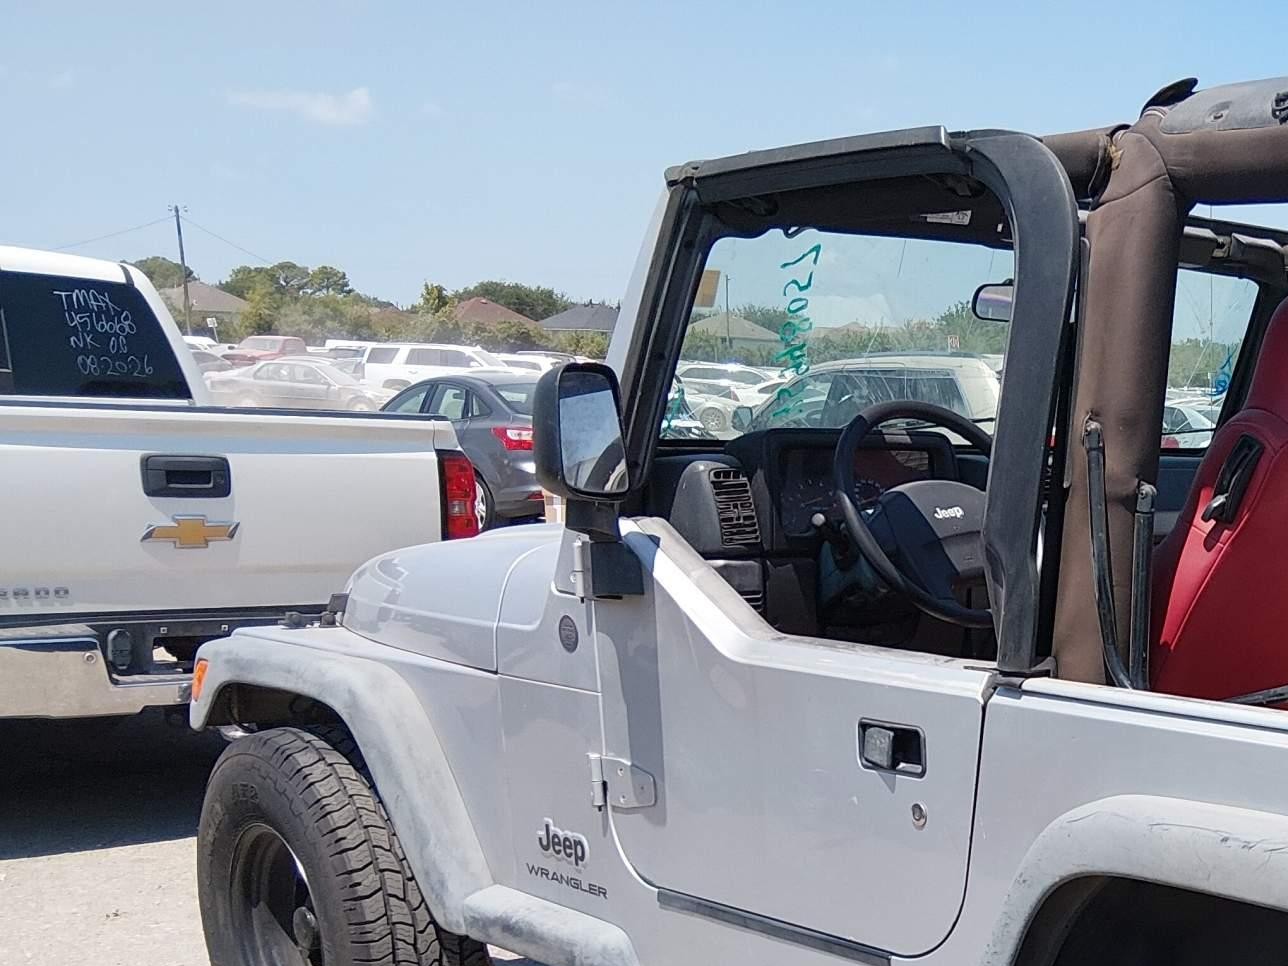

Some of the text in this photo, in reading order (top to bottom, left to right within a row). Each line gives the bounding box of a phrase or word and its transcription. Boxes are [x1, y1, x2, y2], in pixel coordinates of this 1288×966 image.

[53, 289, 121, 315] TMAX
[70, 332, 101, 349] NK
[934, 506, 965, 520] Jeep
[538, 822, 587, 868] Jeep
[526, 862, 608, 900] WRANGLER
